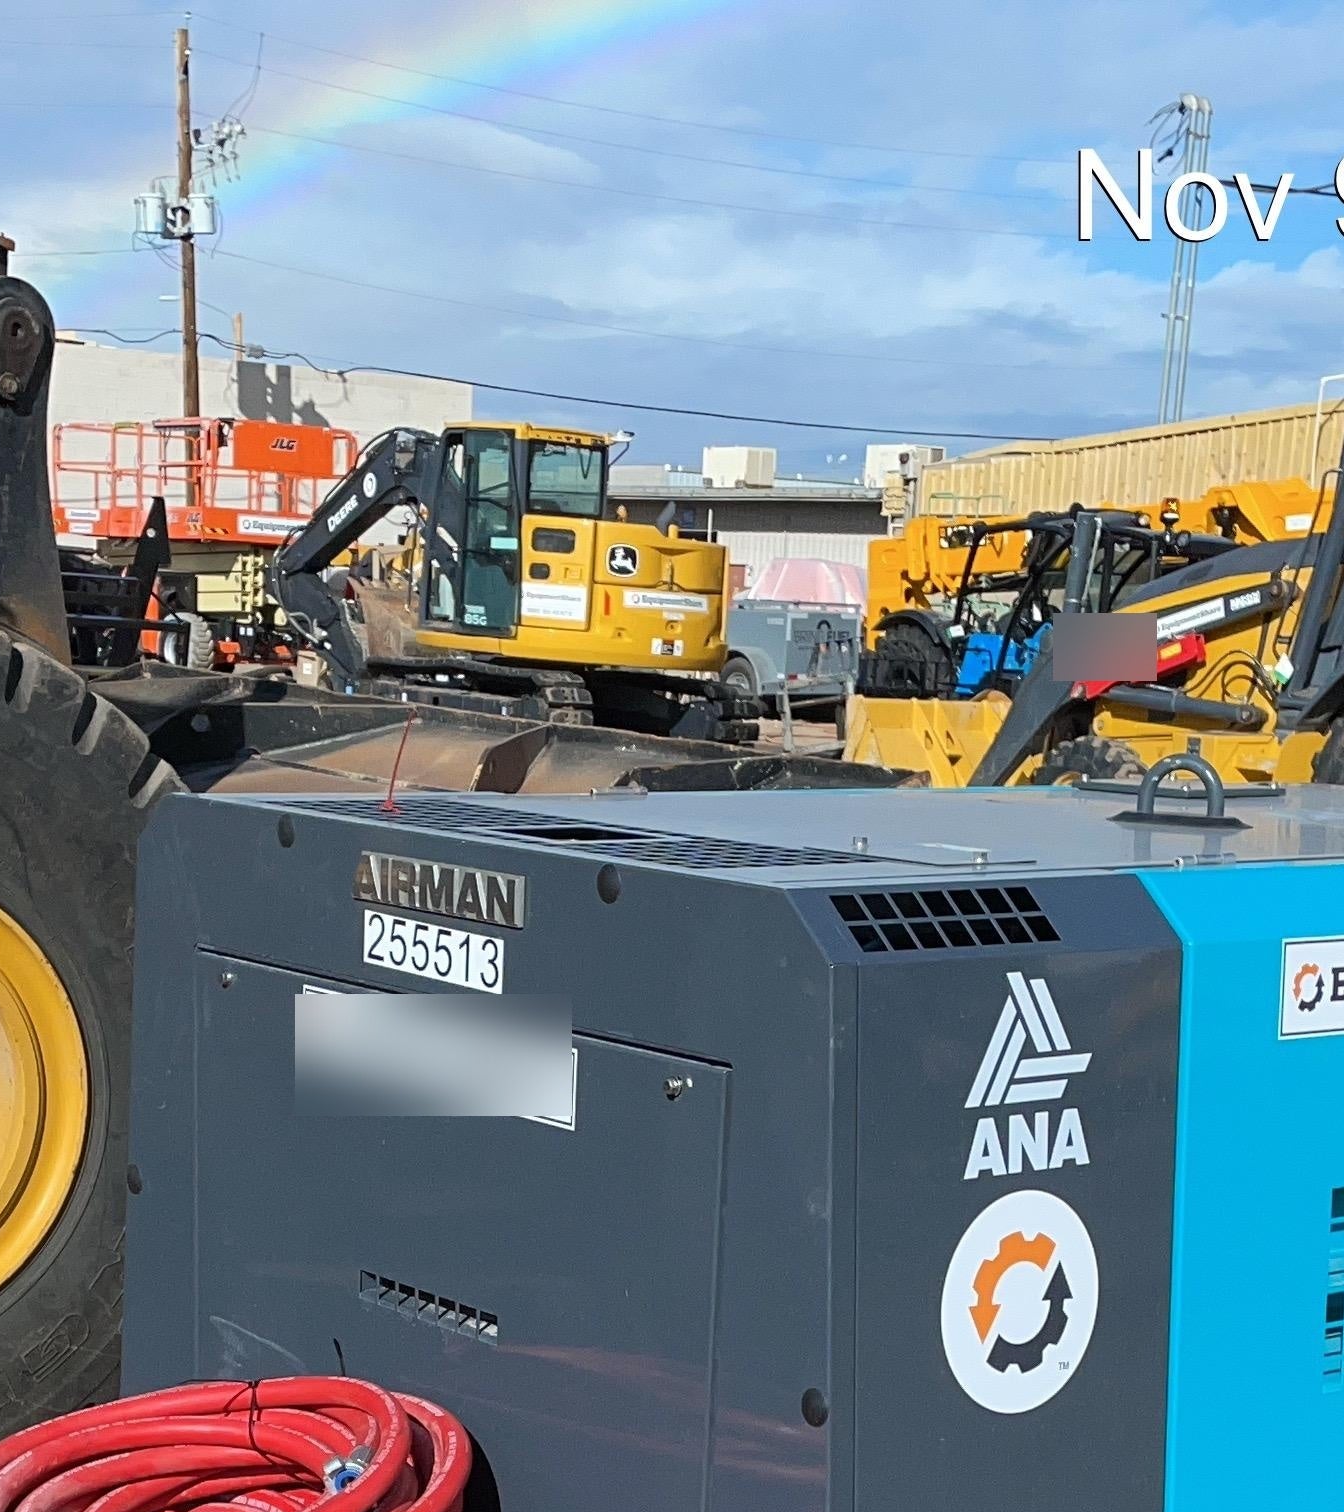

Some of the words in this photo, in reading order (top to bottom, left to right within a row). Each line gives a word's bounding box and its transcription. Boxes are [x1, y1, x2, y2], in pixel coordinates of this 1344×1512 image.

[270, 437, 296, 451] JLG
[327, 495, 359, 533] DEERE
[353, 853, 520, 928] AIRMAN
[367, 913, 500, 989] 255513
[963, 1107, 1090, 1180] ANA
